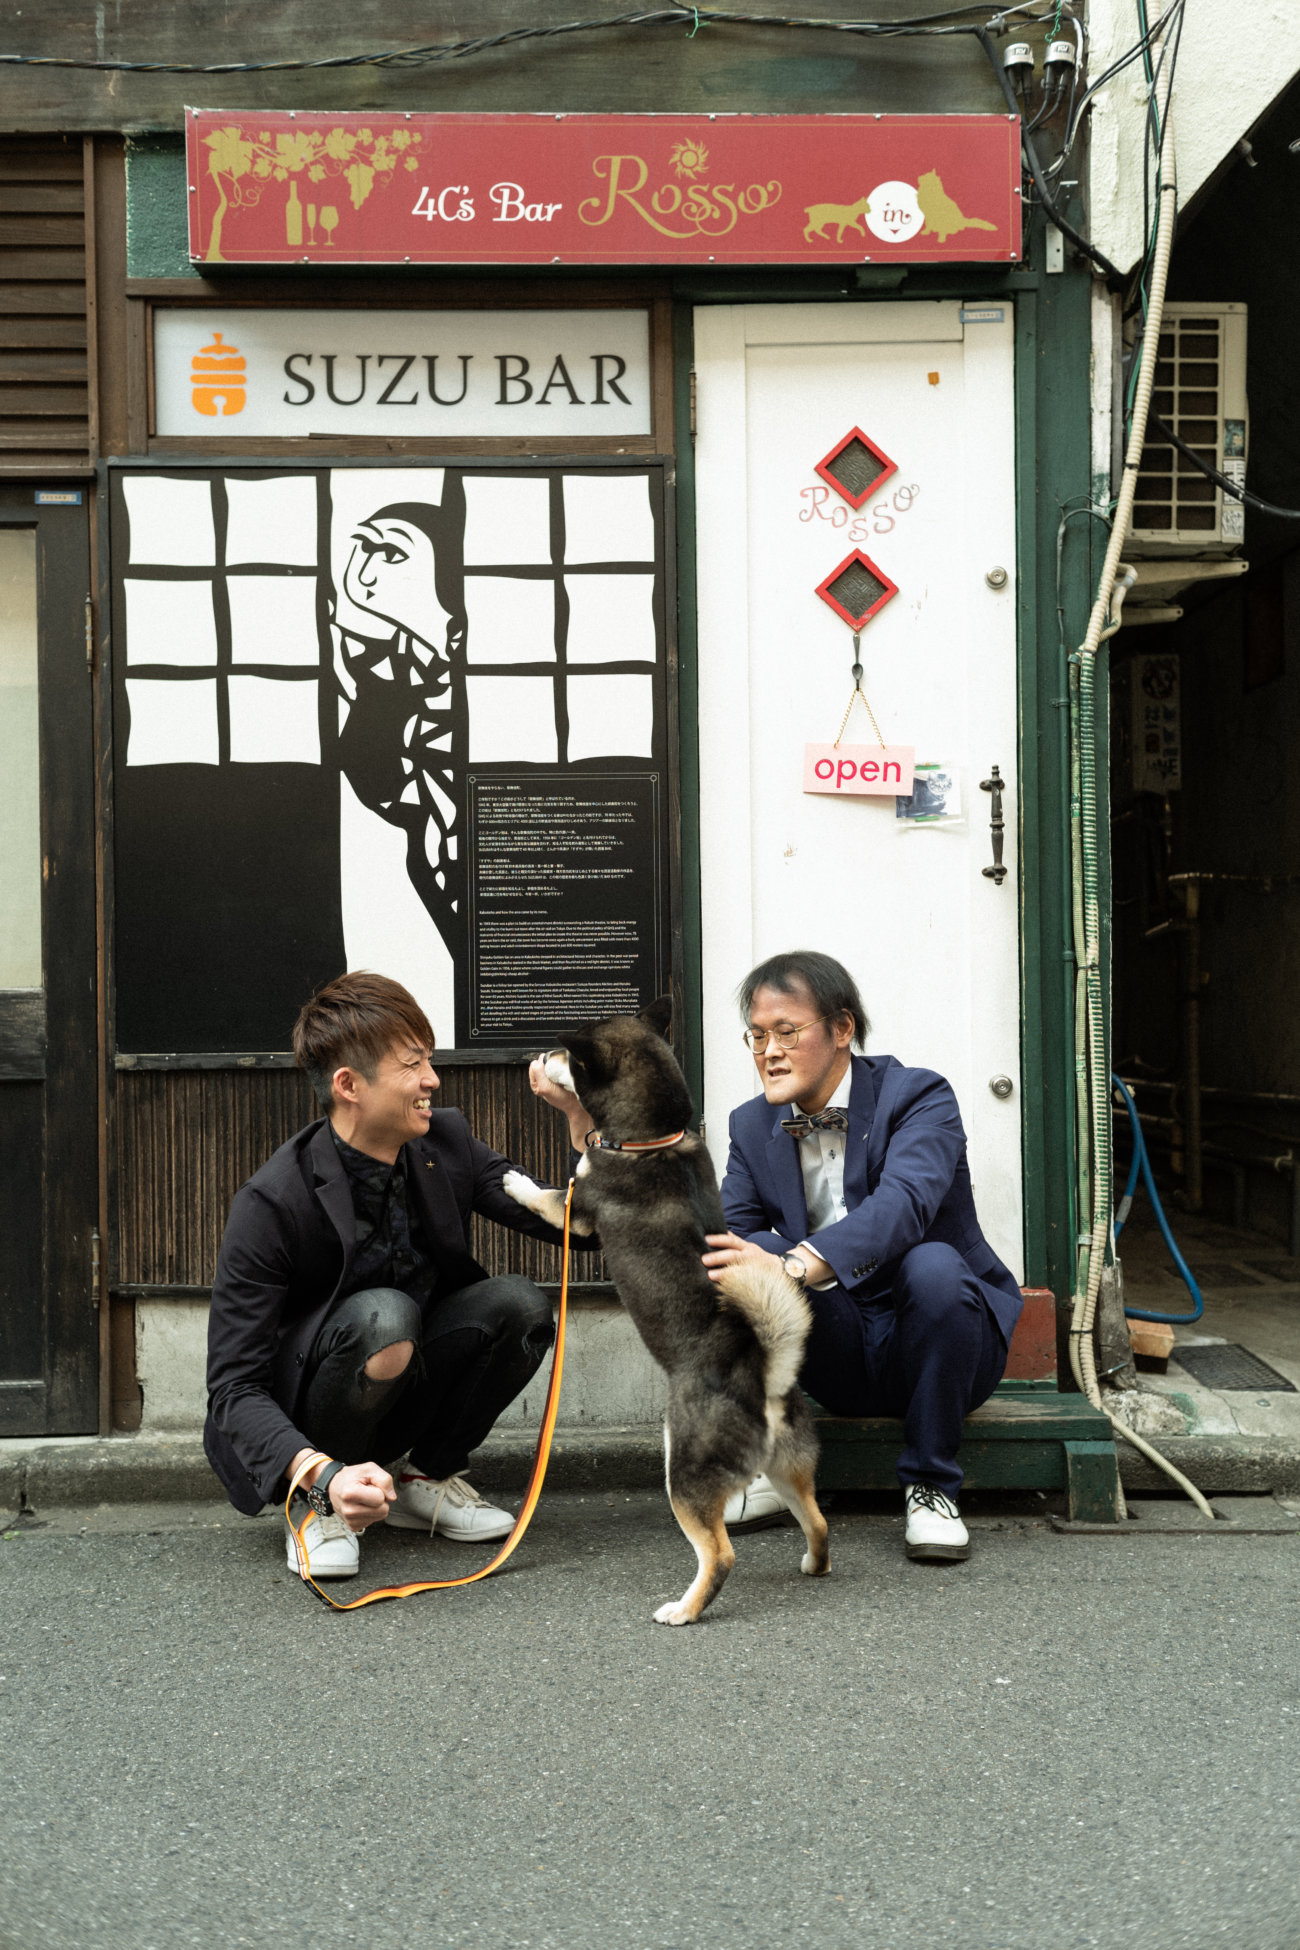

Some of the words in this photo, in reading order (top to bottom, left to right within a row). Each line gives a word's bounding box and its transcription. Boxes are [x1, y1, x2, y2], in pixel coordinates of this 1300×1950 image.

[411, 185, 476, 222] 4C's
[488, 181, 563, 222] Bar
[577, 154, 783, 239] Rosso
[283, 353, 474, 406] SUZU
[493, 353, 632, 406] BAR
[814, 758, 902, 789] open
